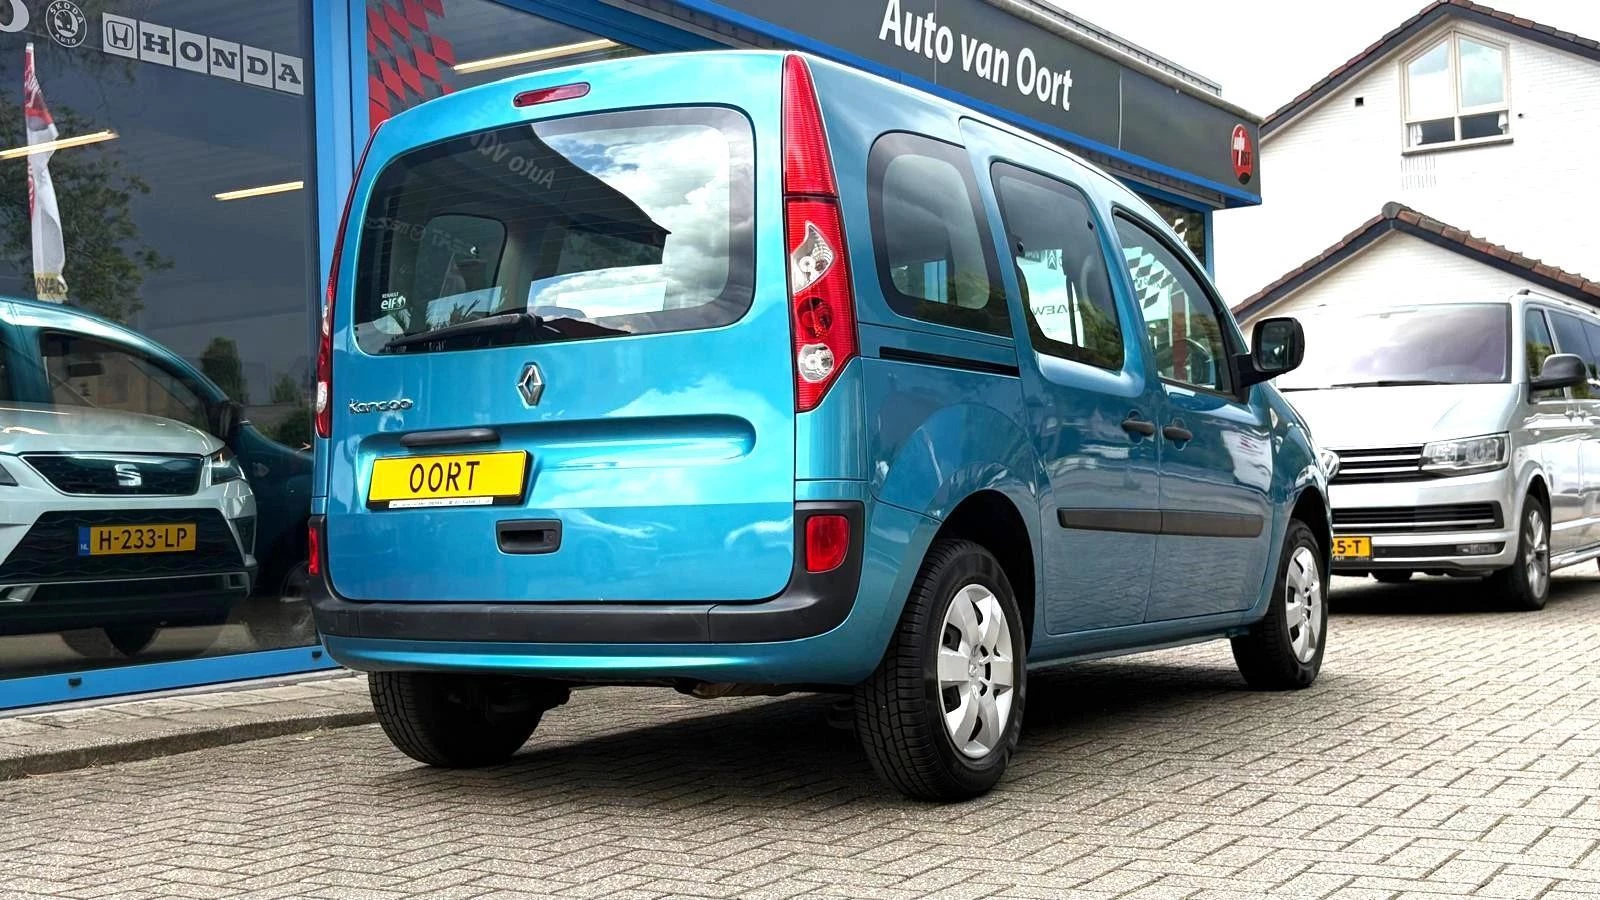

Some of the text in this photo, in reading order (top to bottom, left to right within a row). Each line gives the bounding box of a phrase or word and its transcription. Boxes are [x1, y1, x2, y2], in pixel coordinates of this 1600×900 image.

[142, 32, 301, 85] HONDA
[879, 0, 1073, 111] Auto van Oort
[380, 297, 397, 310] elf
[408, 460, 481, 493] OORT
[99, 527, 187, 551] H-233-LP
[1332, 539, 1362, 554] 5-T
